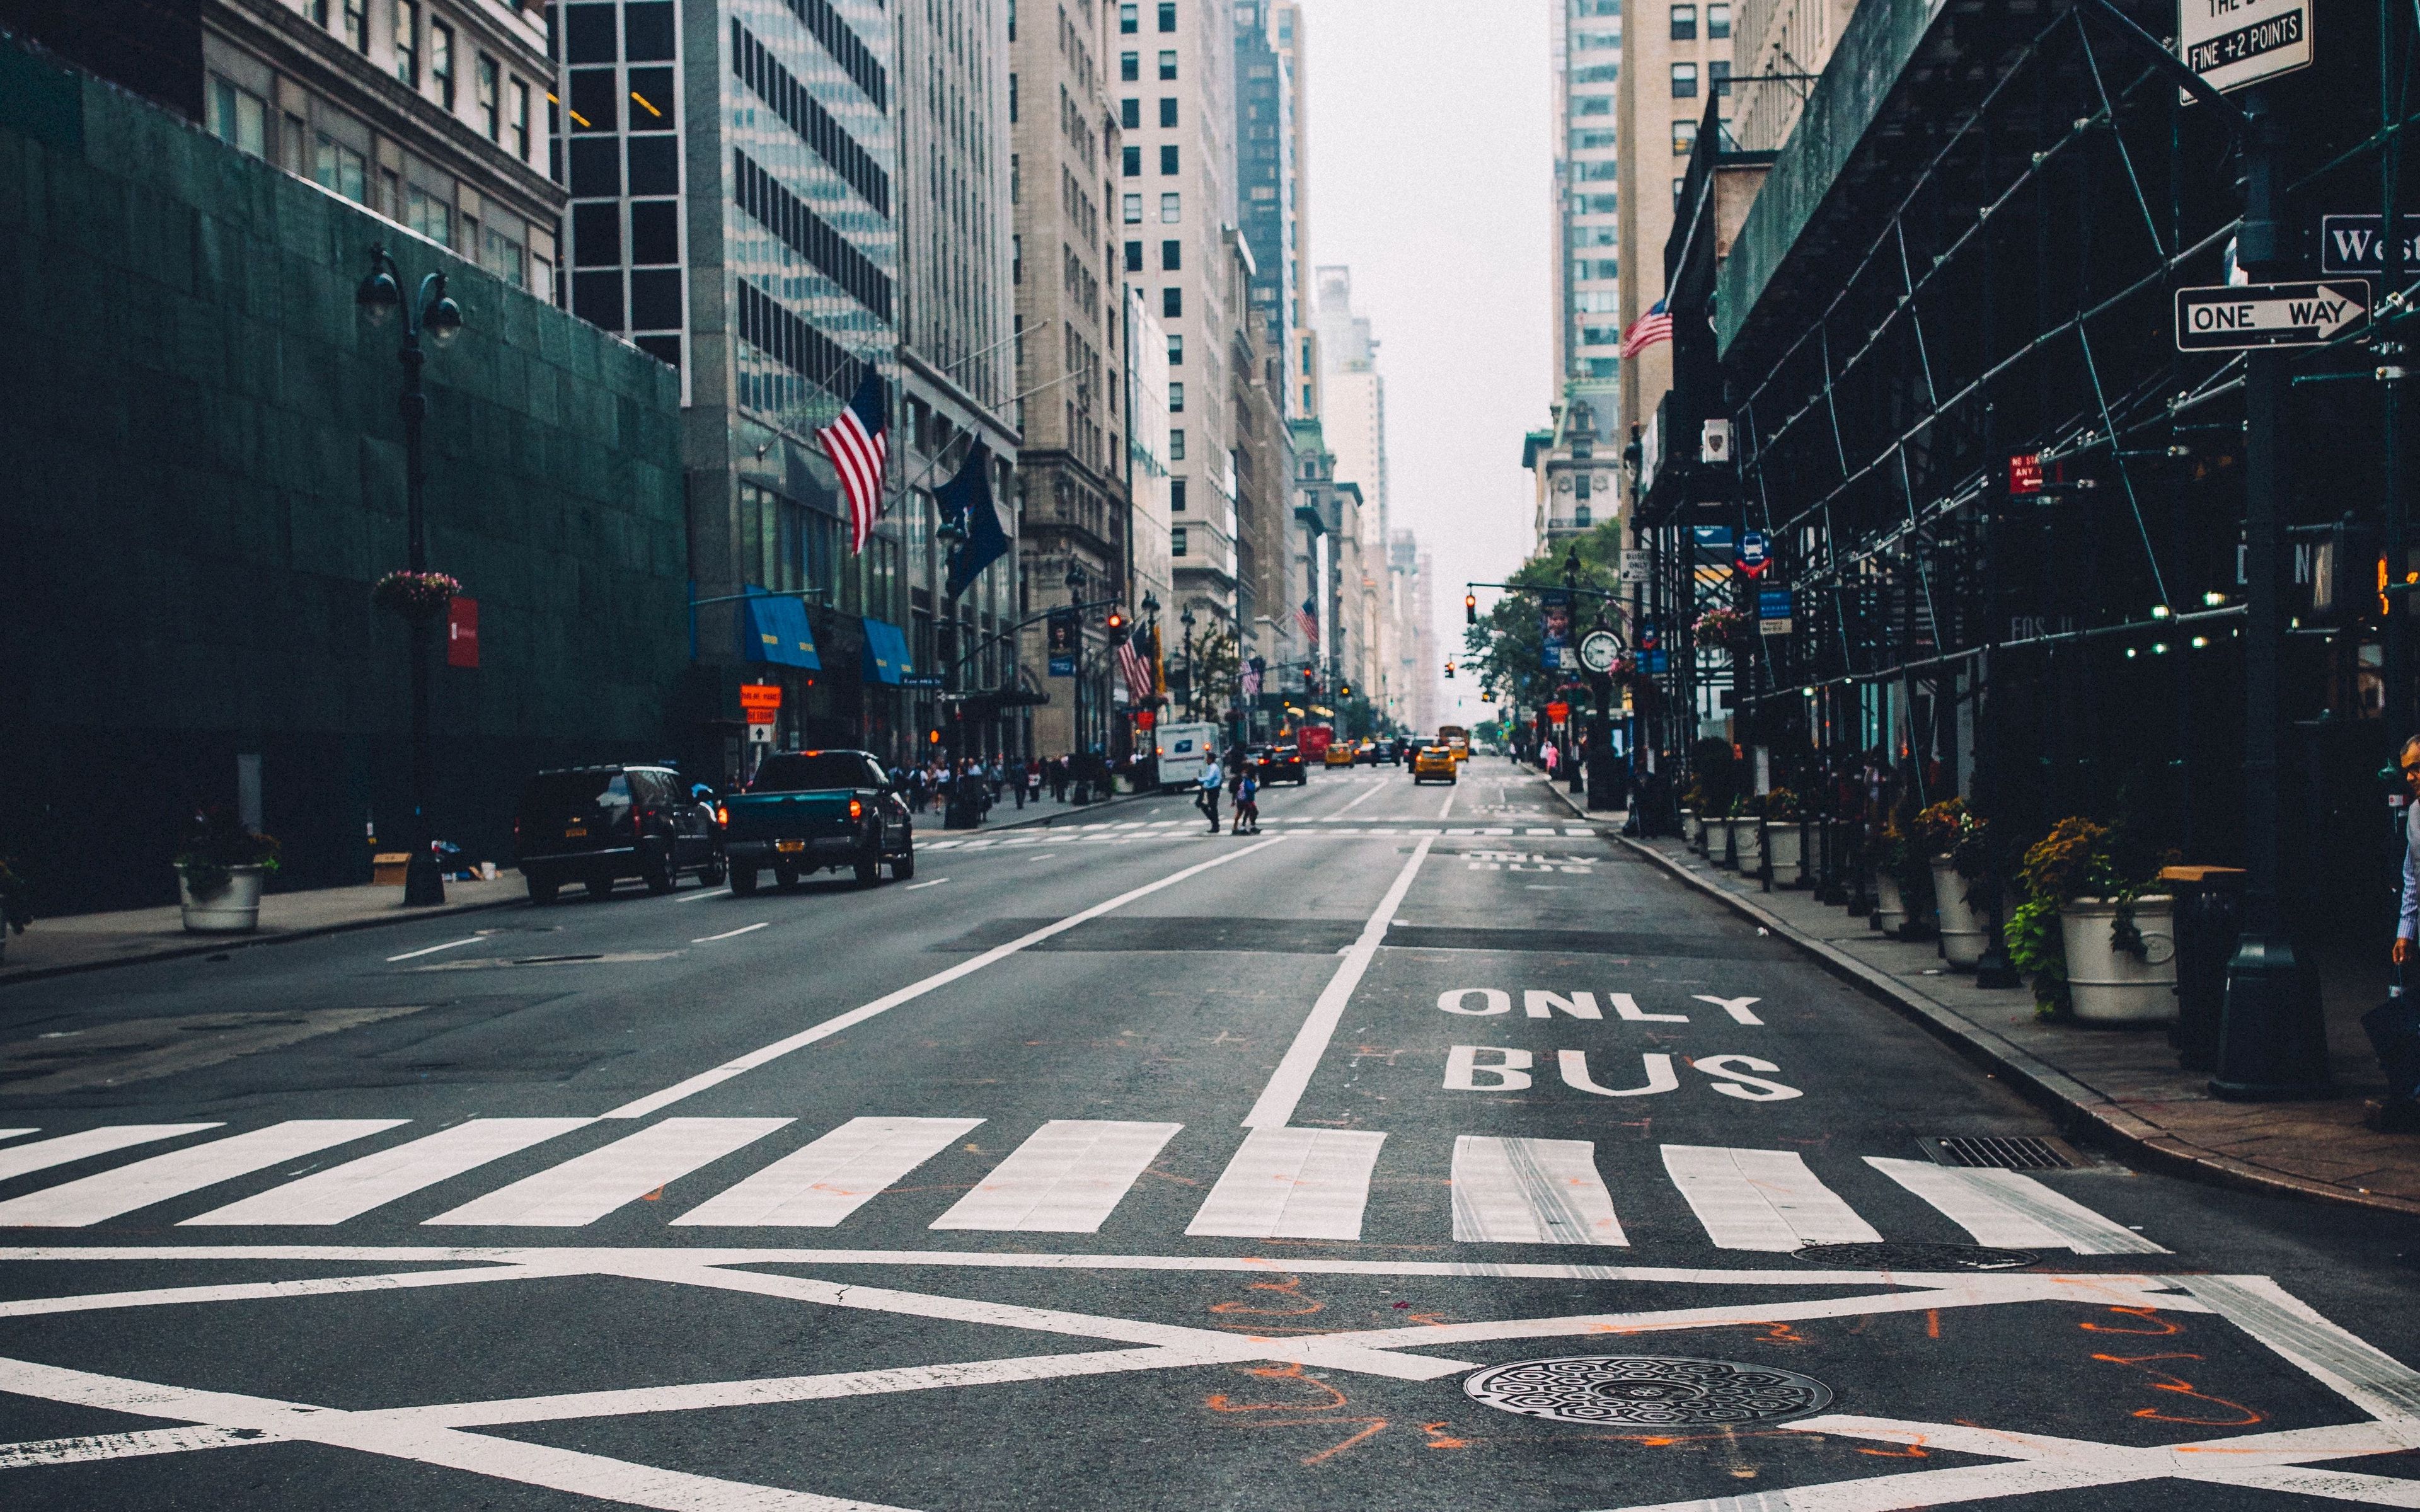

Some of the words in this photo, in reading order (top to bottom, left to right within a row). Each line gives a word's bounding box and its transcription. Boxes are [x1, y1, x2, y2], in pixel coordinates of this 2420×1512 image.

[2192, 41, 2220, 72] FINE
[2225, 33, 2245, 57] +2
[2250, 15, 2298, 52] POINTS
[2194, 305, 2255, 330] ONE
[2289, 299, 2348, 325] WAY
[1438, 988, 1764, 1025] ONLY
[1443, 1045, 1804, 1102] BUS
